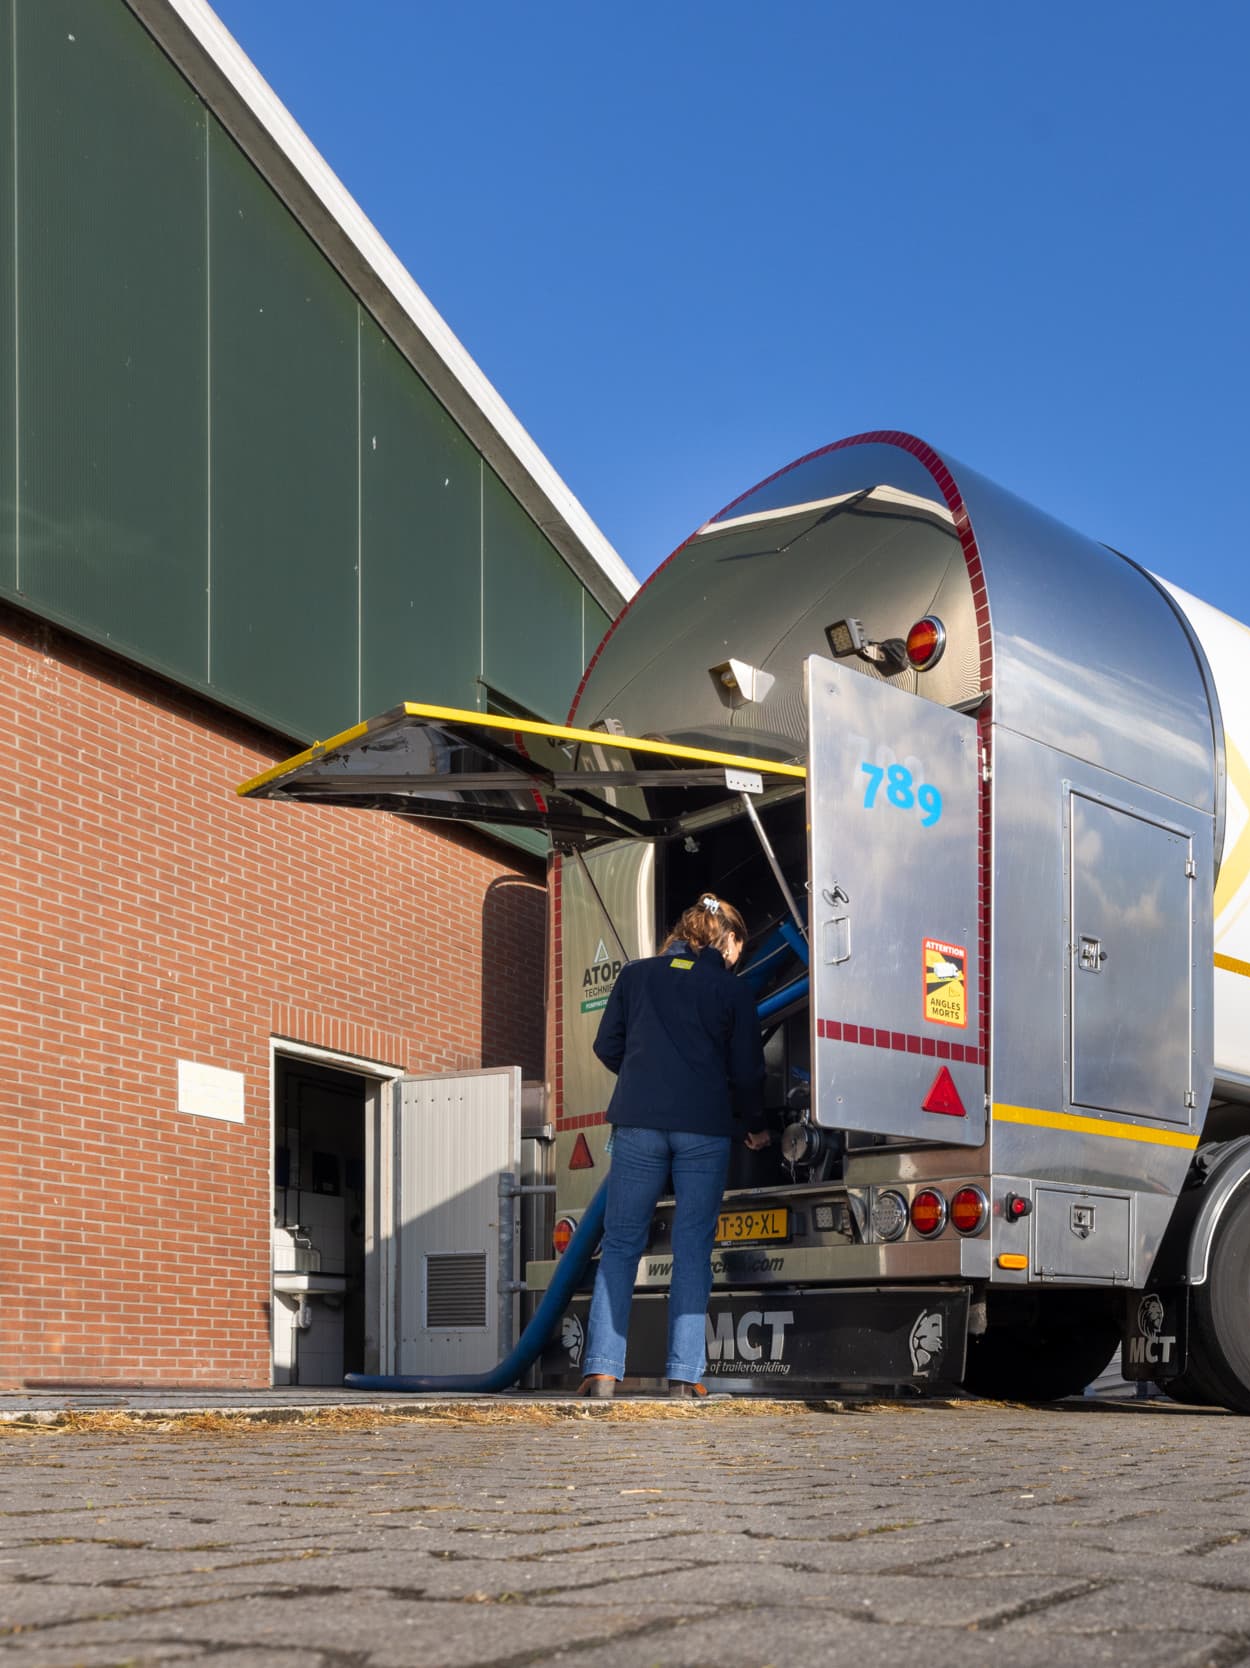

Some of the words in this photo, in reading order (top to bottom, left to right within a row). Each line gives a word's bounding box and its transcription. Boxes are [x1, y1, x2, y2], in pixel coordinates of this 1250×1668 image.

[861, 762, 943, 828] 789
[925, 941, 965, 957] ATTENTION
[584, 984, 613, 998] TECHNIE
[930, 997, 961, 1011] ANGLES
[932, 1007, 960, 1020] MORTS
[1130, 1336, 1176, 1363] MCT
[710, 1361, 721, 1375] of
[722, 1361, 791, 1375] trailerbuilding
